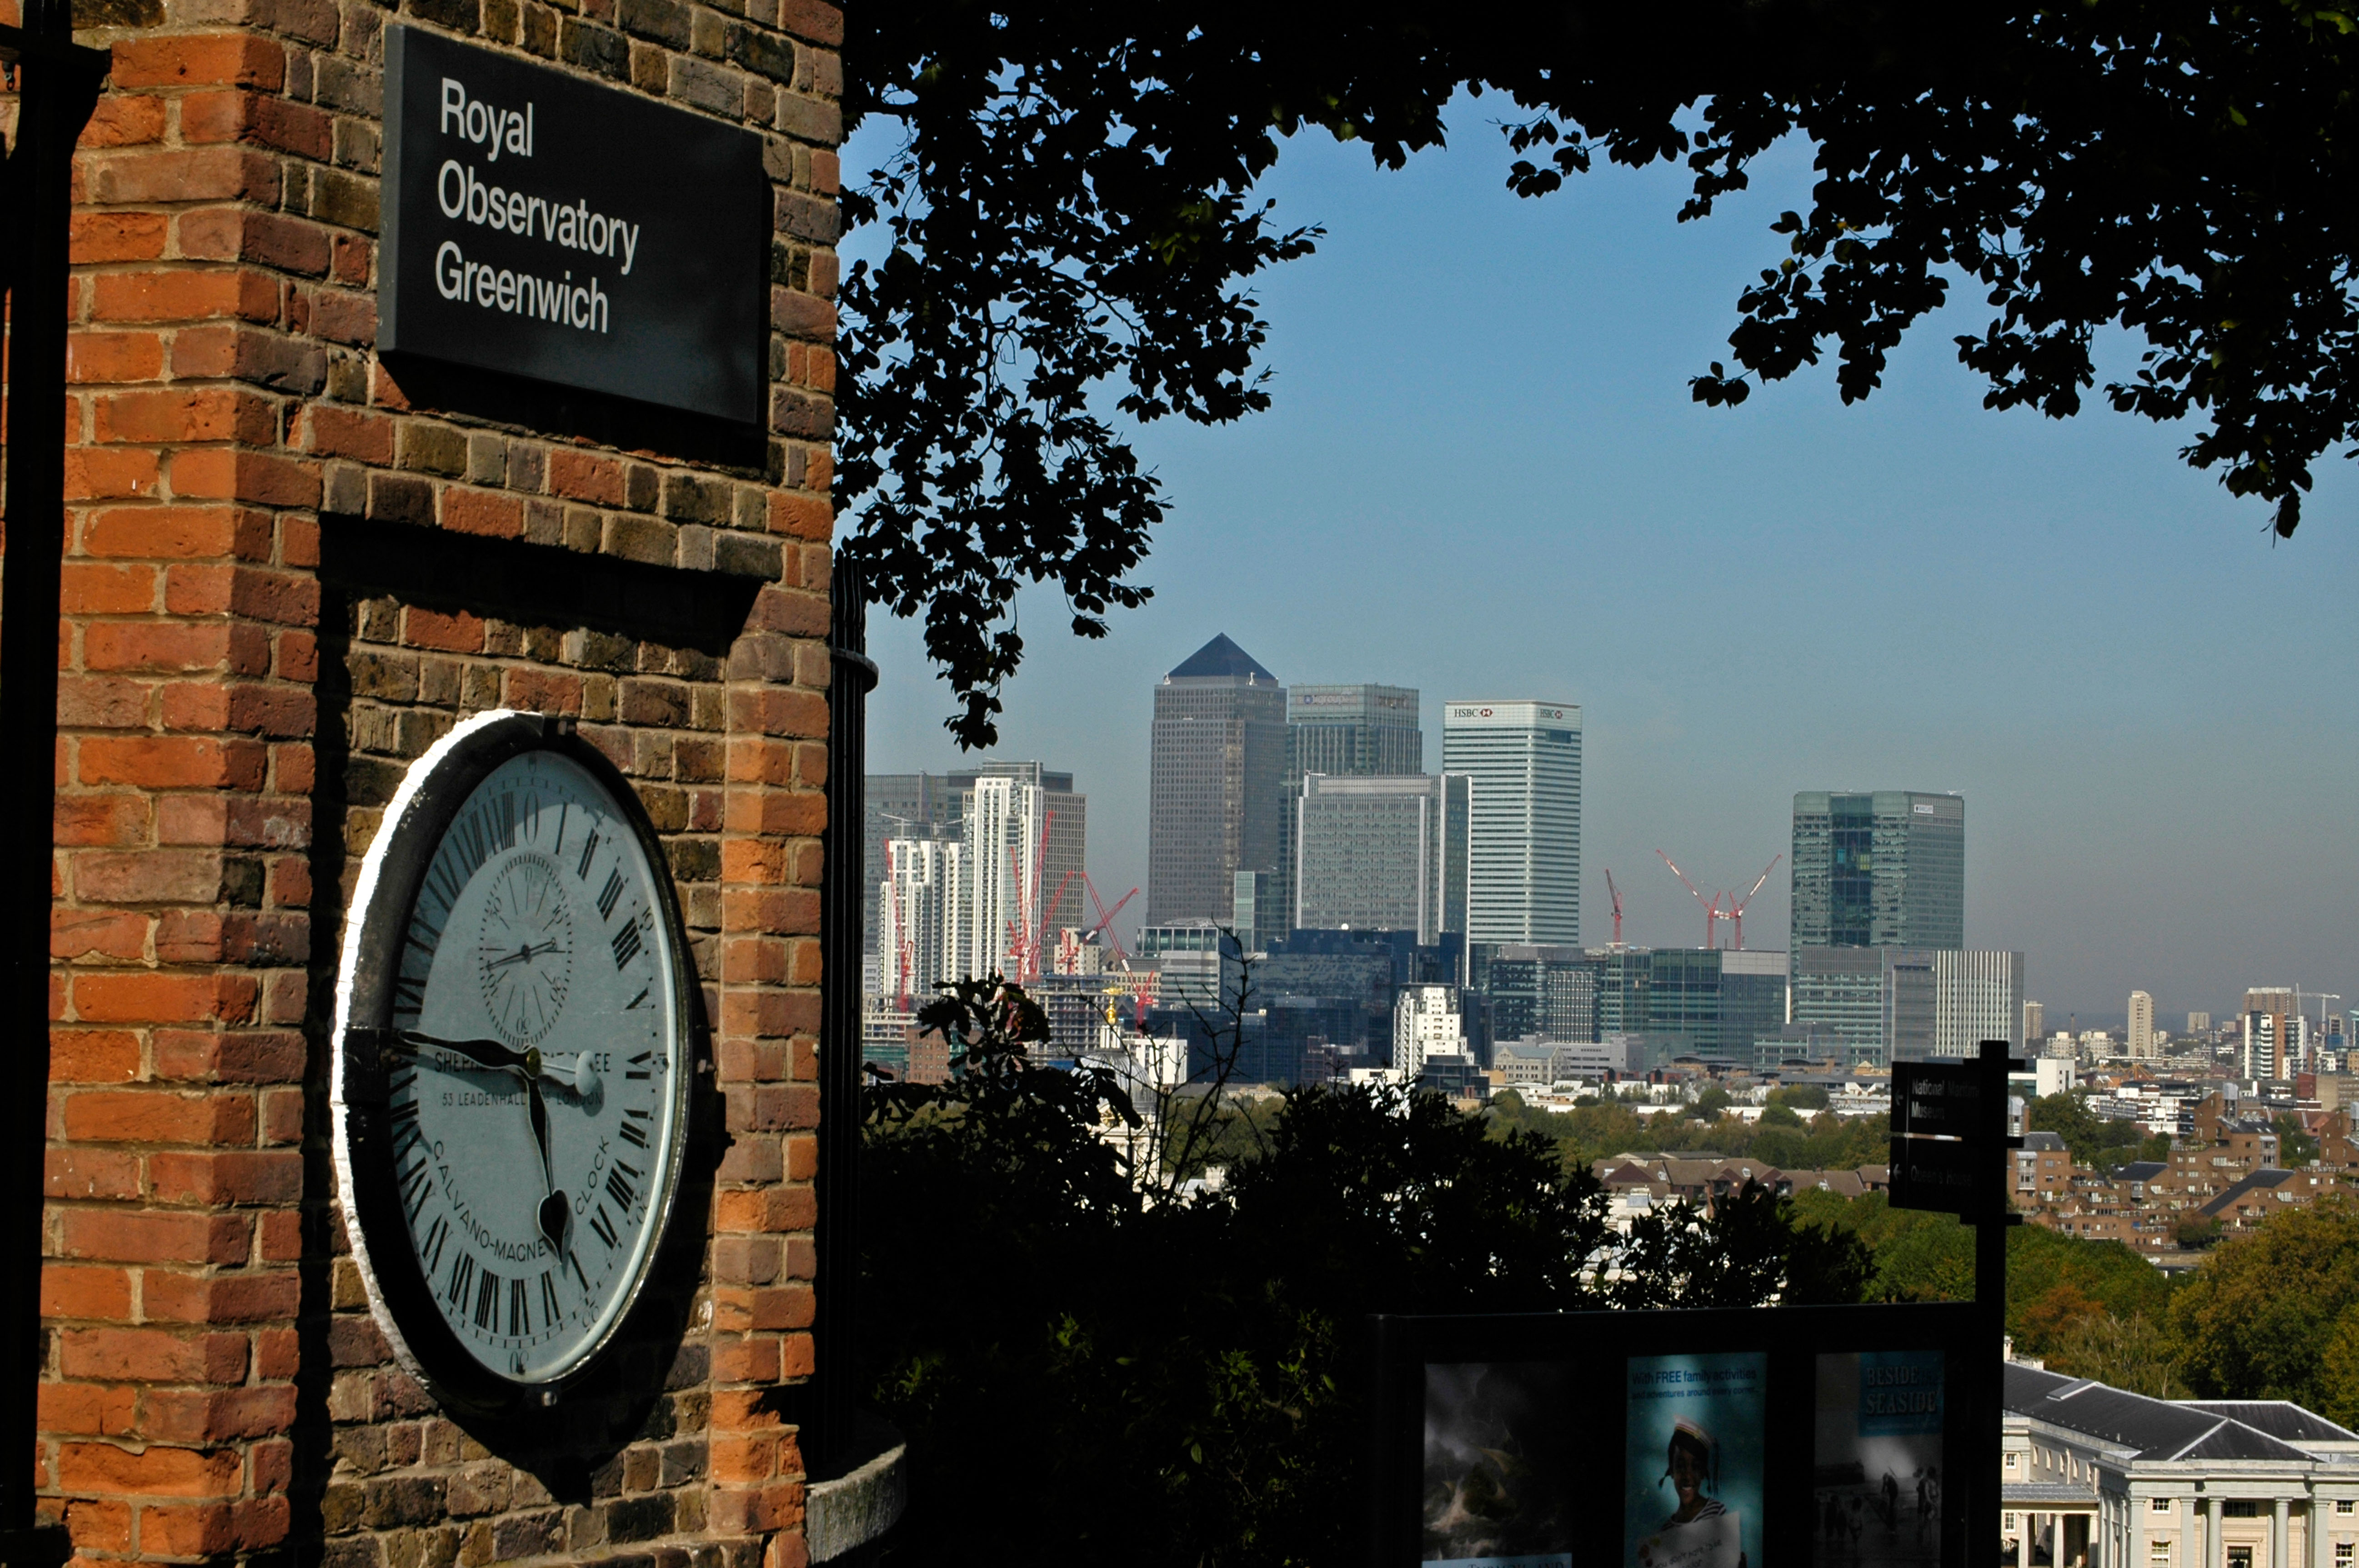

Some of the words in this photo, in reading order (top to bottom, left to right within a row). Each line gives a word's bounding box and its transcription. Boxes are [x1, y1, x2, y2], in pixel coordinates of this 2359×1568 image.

[441, 77, 534, 162] Royal
[438, 159, 639, 275] Observatory
[435, 240, 608, 333] Greenwich
[1454, 709, 1478, 717] HSBC
[1540, 709, 1554, 719] HSBC
[524, 790, 538, 845] 0
[1912, 1078, 1945, 1096] National
[441, 1094, 453, 1106] 53
[459, 1092, 526, 1106] LEADENHALL
[557, 1092, 602, 1105] LONDON
[1911, 1100, 1945, 1120] Museum
[1910, 1164, 1943, 1185] Queen's
[1946, 1168, 1972, 1188] House
[434, 1140, 546, 1262] GALVANO-MAGNE
[575, 1135, 610, 1215] CLOCK
[1632, 1372, 1653, 1385] With
[1656, 1370, 1682, 1383] FREE
[1683, 1369, 1710, 1383] family
[1713, 1368, 1757, 1381] activities
[1866, 1365, 1919, 1388] BESIDE
[1632, 1390, 1645, 1399] and
[1647, 1389, 1685, 1399] adventures
[1687, 1388, 1711, 1398] around
[1865, 1391, 1937, 1416] SEASIDE
